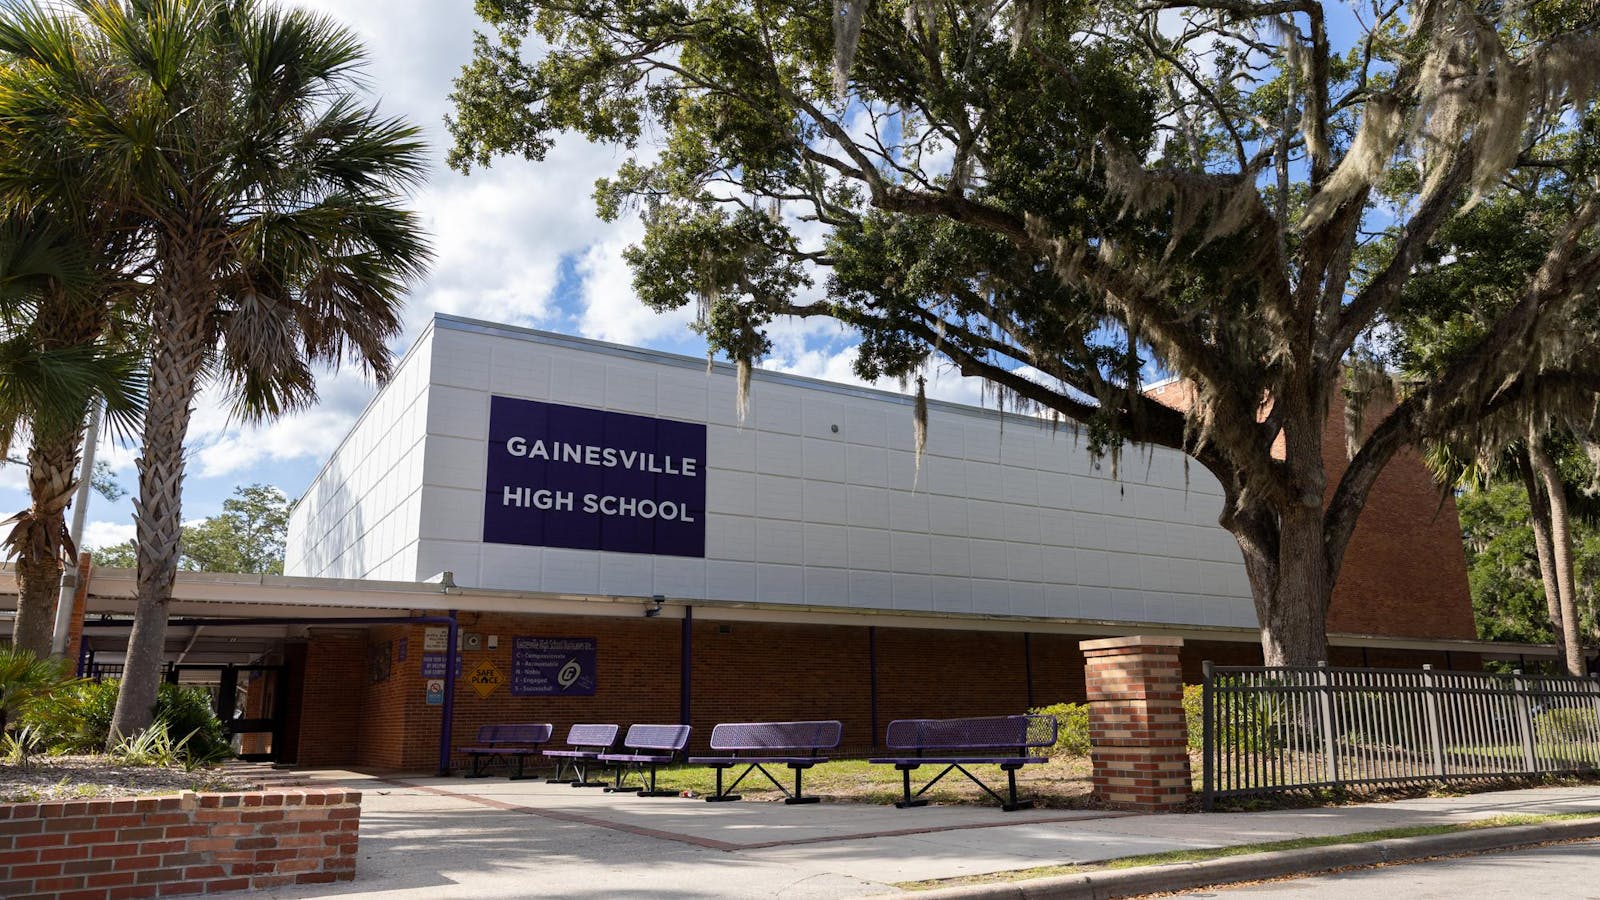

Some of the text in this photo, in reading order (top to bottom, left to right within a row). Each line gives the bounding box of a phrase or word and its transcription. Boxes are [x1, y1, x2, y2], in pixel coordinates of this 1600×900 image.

[506, 436, 697, 477] GAINESVILLE
[503, 486, 695, 523] HIGH SCHOOL
[476, 669, 494, 677] SAFE
